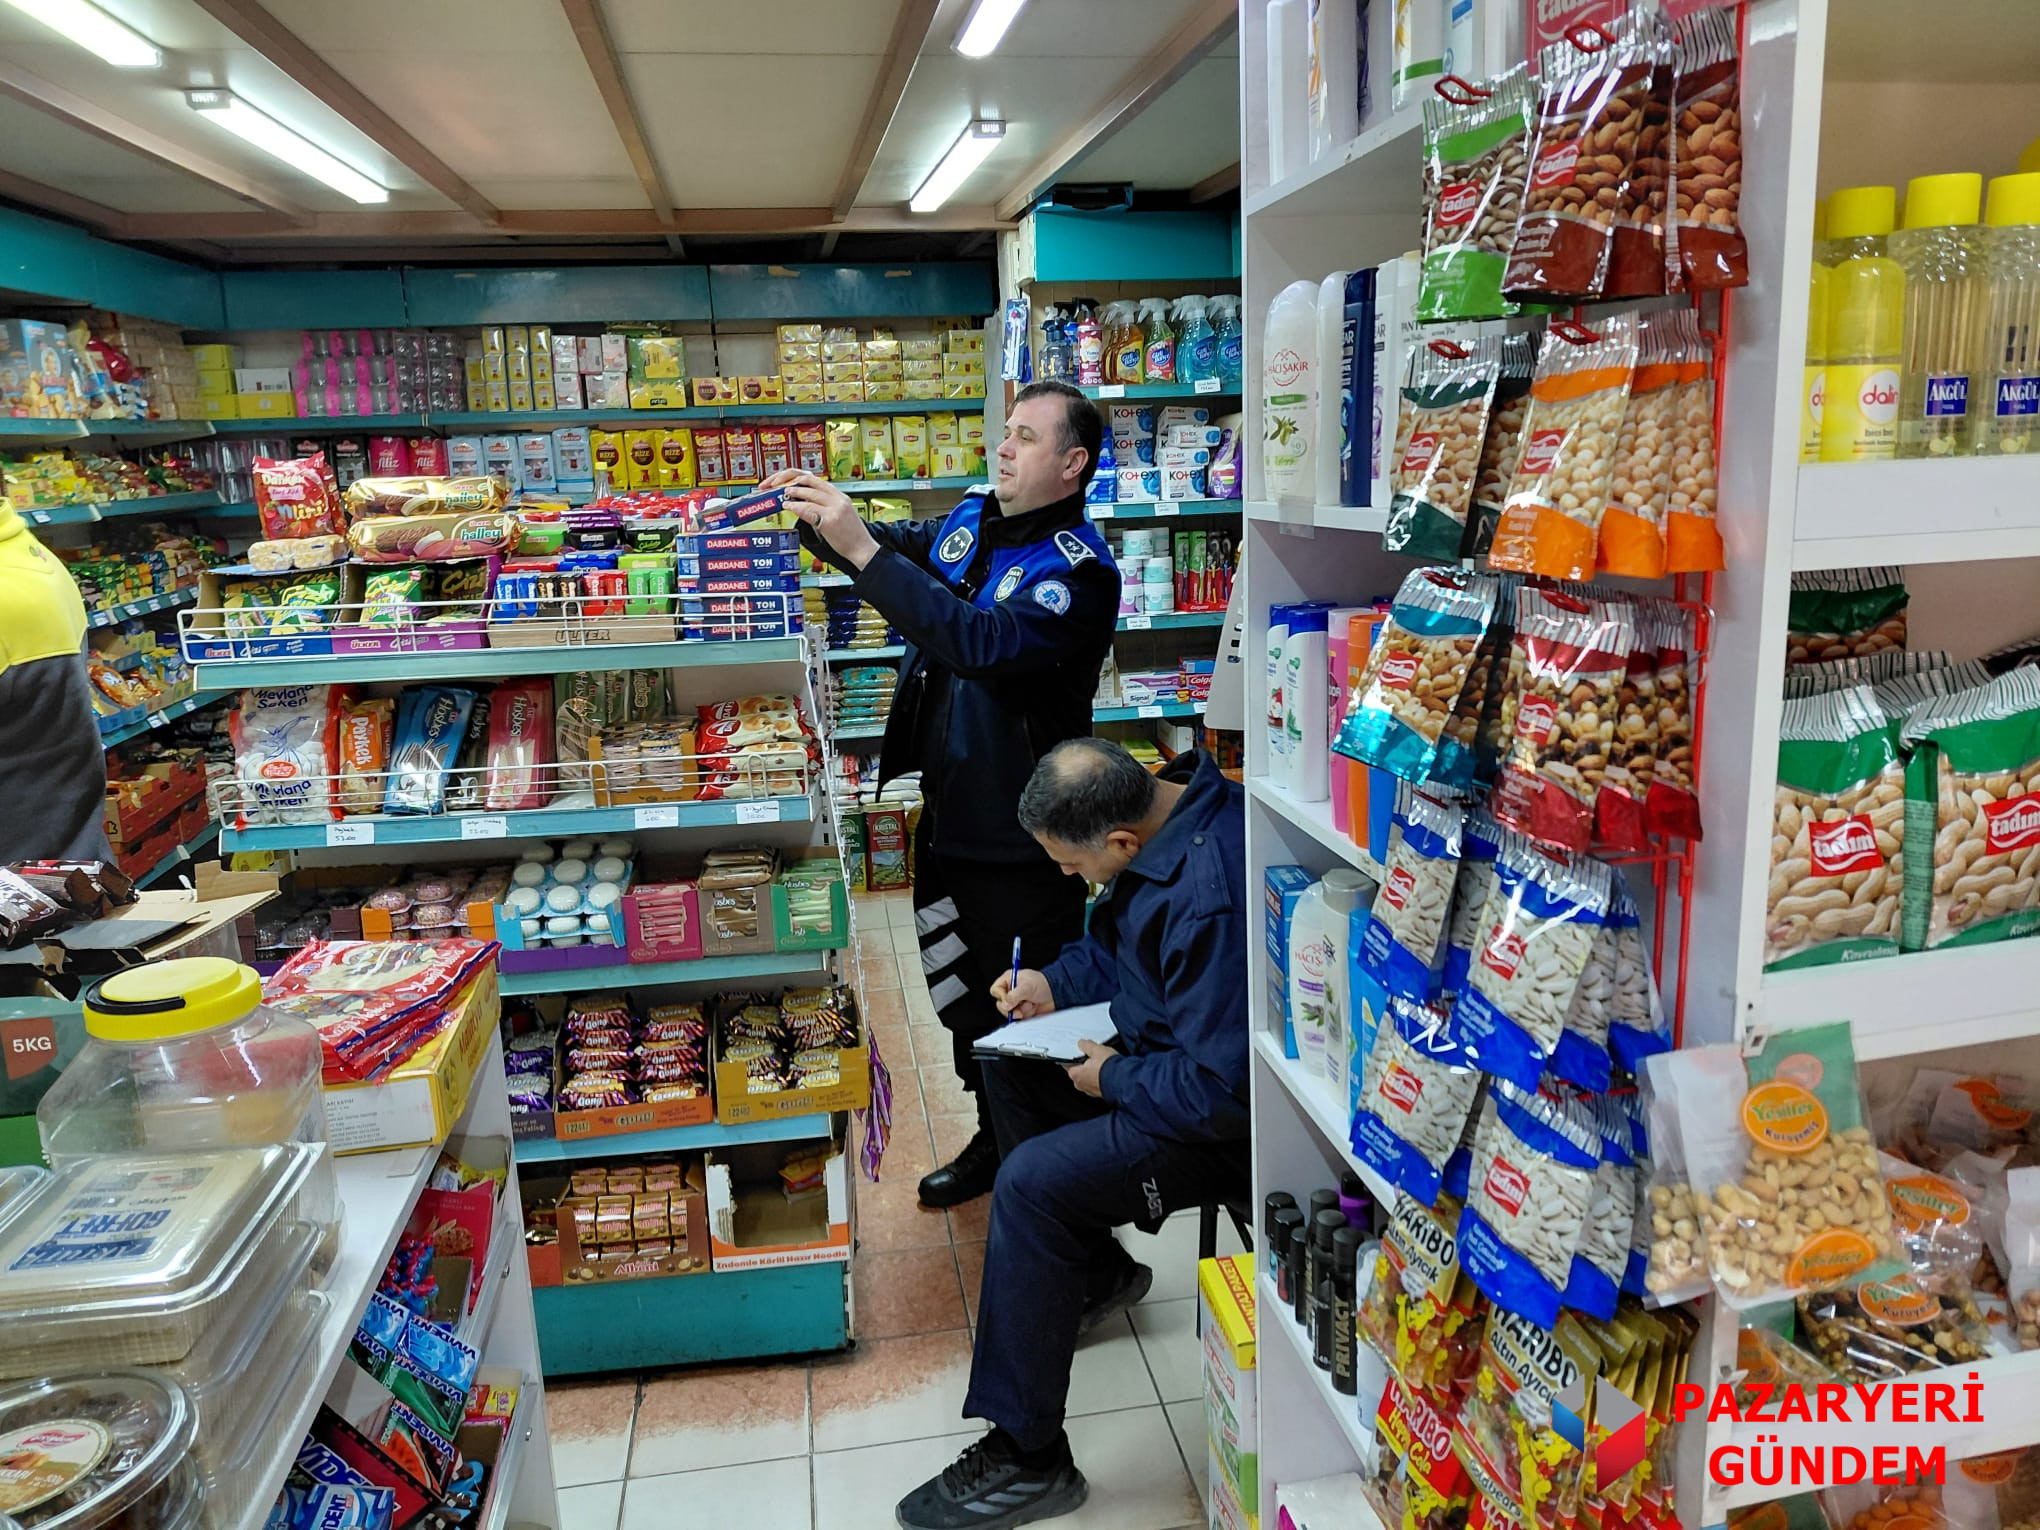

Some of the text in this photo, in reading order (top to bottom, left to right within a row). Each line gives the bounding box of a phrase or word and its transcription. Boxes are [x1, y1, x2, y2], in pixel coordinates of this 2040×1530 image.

[736, 493, 791, 519] DARDANEL TO
[461, 527, 503, 545] halley
[707, 537, 772, 548] DARDANEL TON
[708, 559, 772, 570] DARDANEL TON
[708, 579, 772, 591] DARDANEL TON
[756, 601, 776, 609] TON
[352, 639, 381, 649] ÜLKER
[1812, 827, 1876, 857] tadım
[12, 1035, 53, 1053] 5KG
[511, 1104, 528, 1114] ong
[578, 1097, 602, 1107] Gong
[1488, 1165, 1526, 1204] tadım
[1393, 1195, 1455, 1266] HARIBO
[717, 1260, 757, 1269] Indomie
[813, 1251, 847, 1260] Noodle
[409, 1317, 476, 1360] VIVIDENT
[1335, 1295, 1350, 1378] PRIVACY
[392, 1361, 462, 1404] VIVIDENT
[391, 1405, 454, 1462] VIVIDENT
[1409, 1442, 1432, 1475] Cola
[1469, 1458, 1522, 1519] Goldbears
